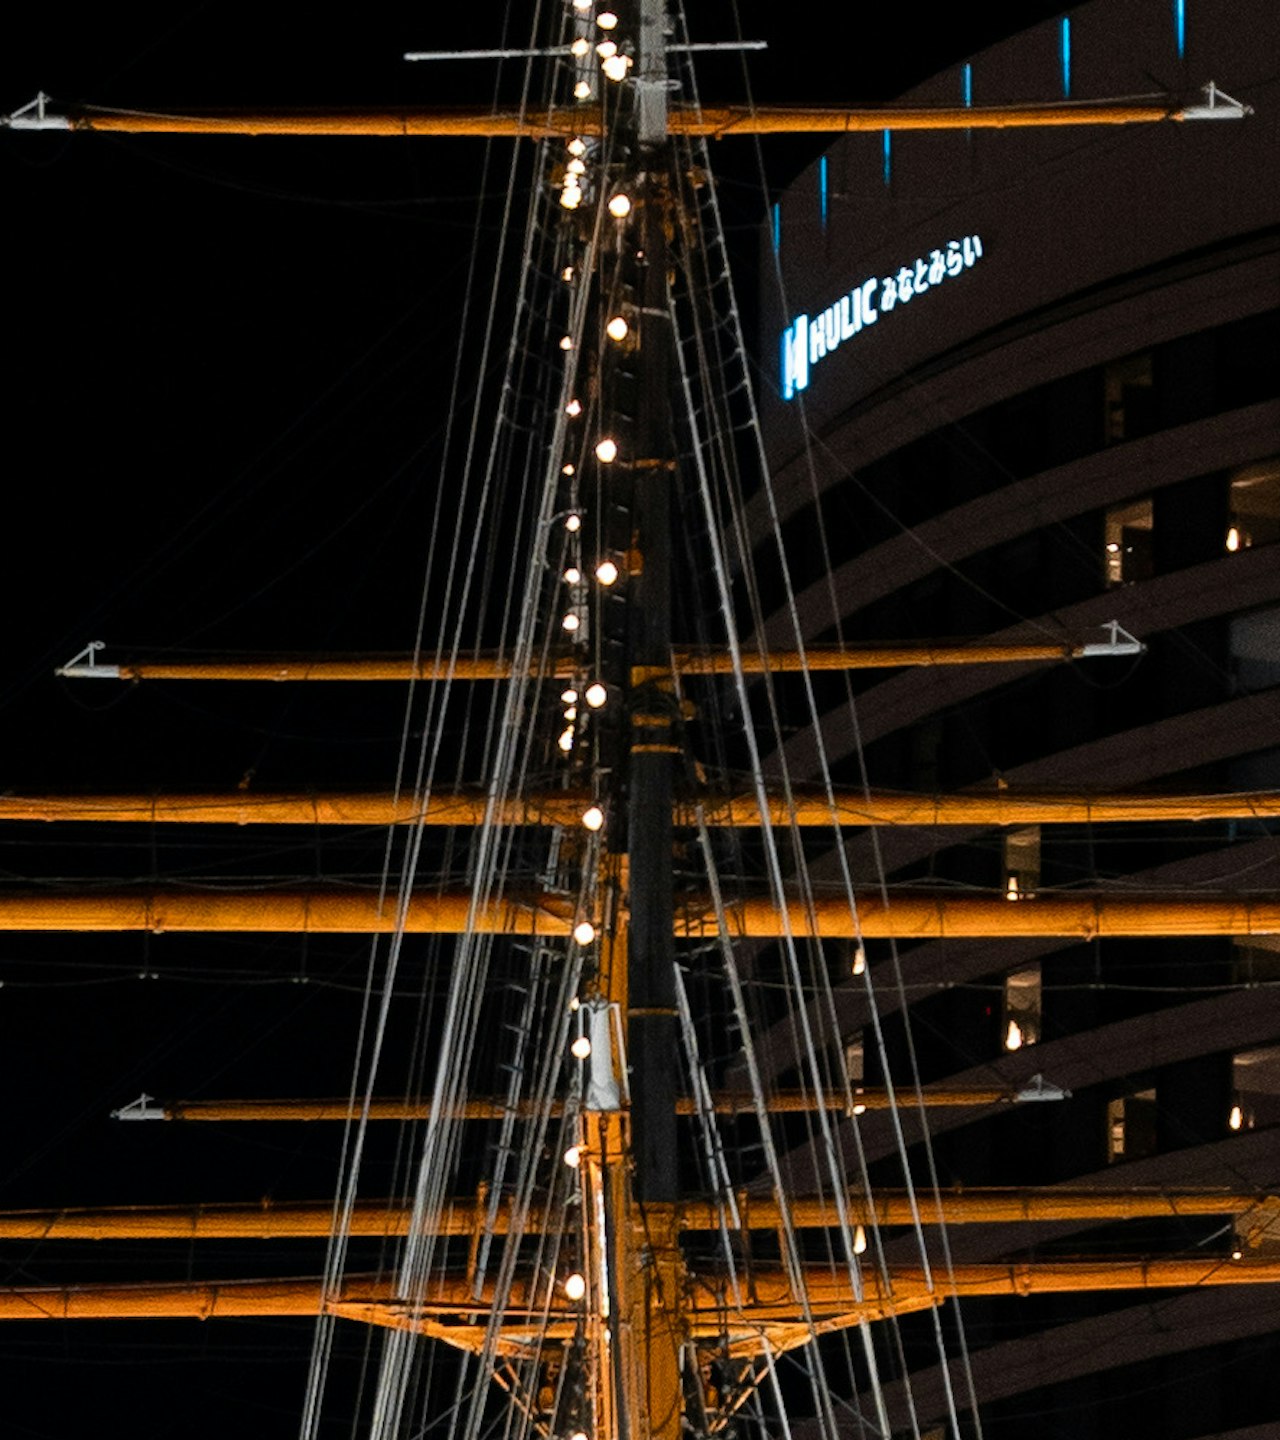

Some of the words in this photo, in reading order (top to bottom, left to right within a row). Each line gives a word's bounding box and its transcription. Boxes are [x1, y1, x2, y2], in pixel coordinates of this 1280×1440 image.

[809, 277, 878, 364] HULIC
[880, 235, 984, 311] みなとみらい
